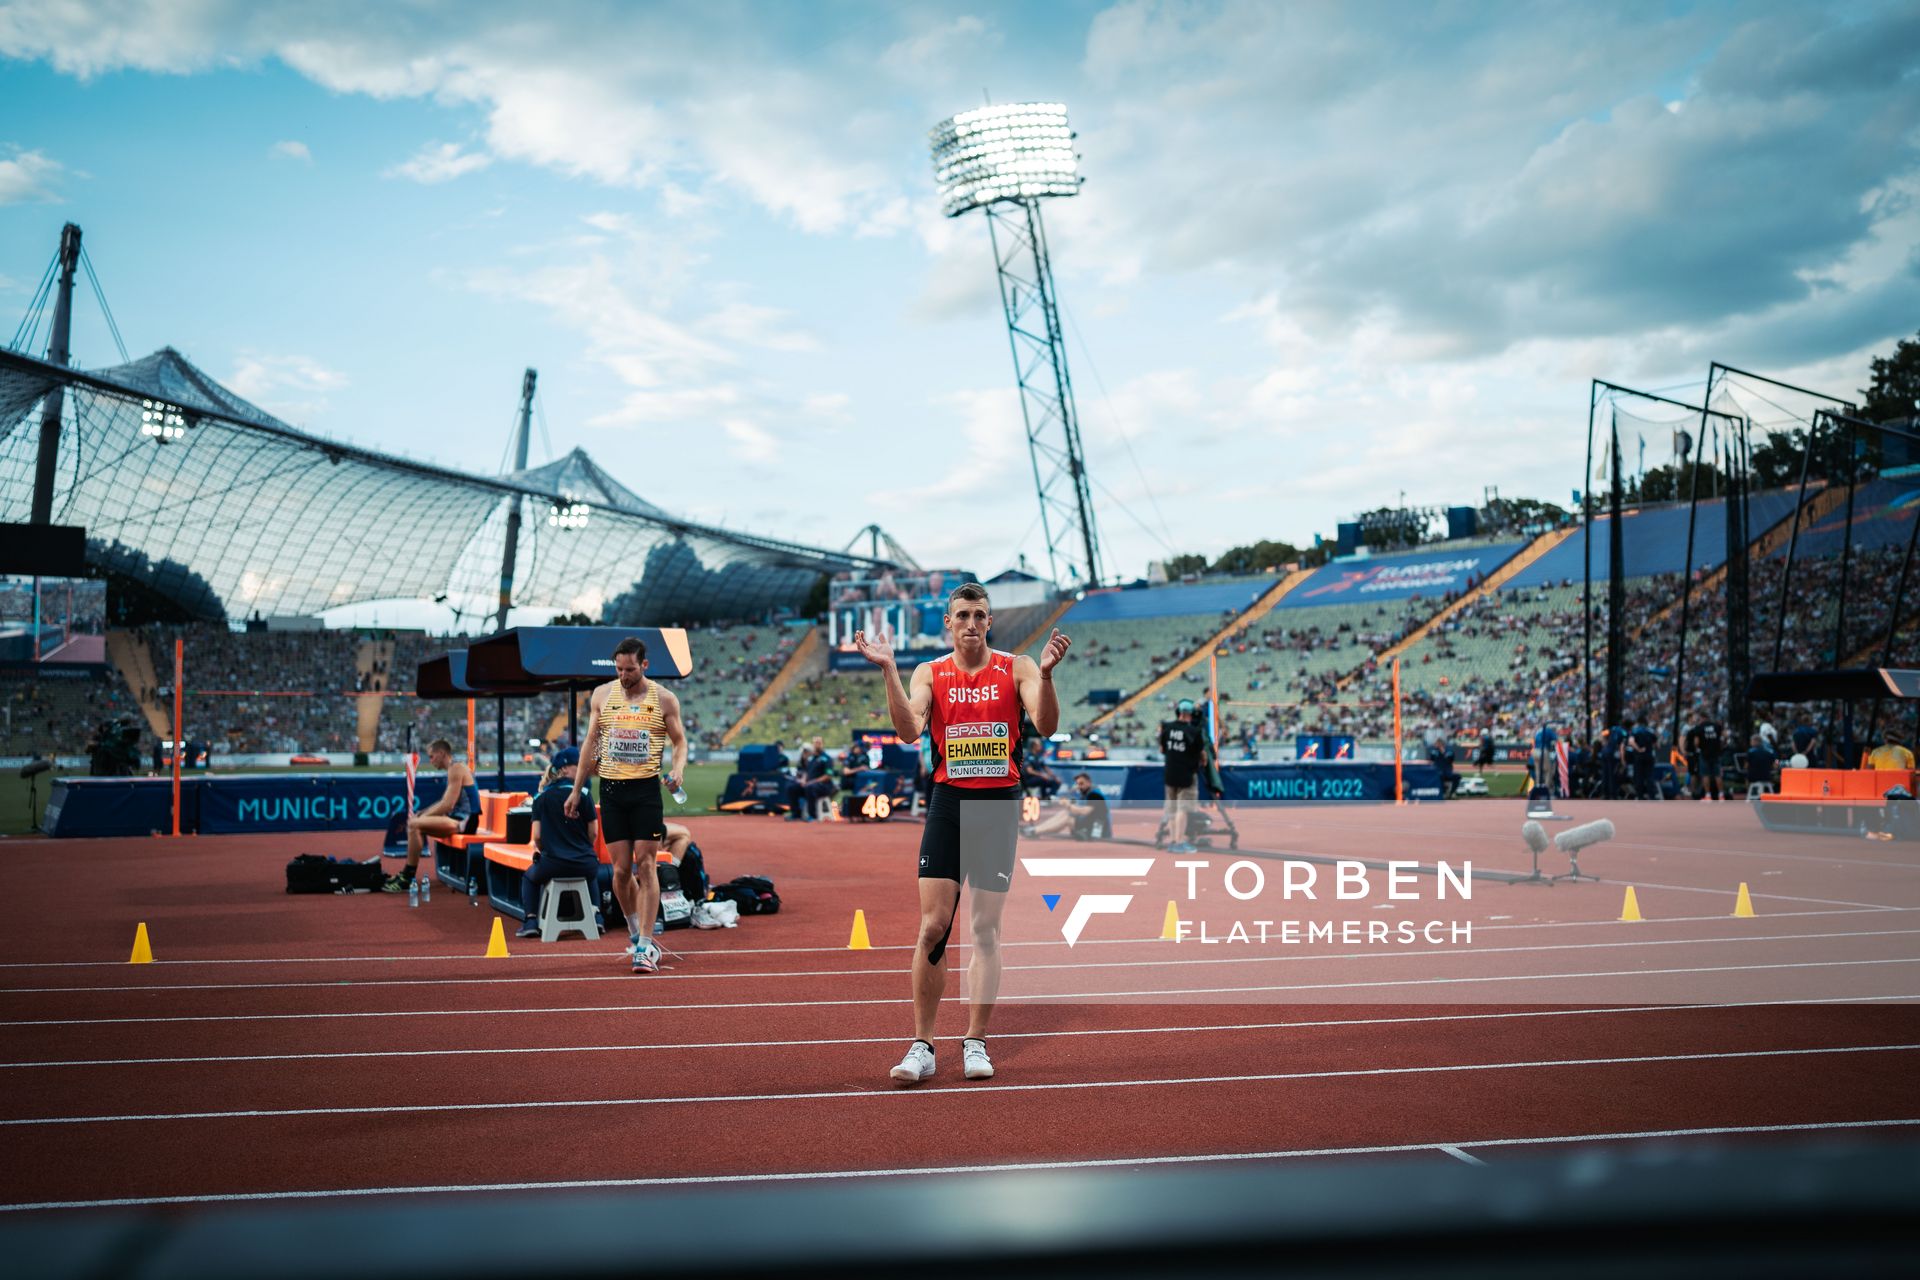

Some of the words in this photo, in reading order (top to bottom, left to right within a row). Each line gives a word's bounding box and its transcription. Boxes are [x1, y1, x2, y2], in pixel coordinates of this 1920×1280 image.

[948, 725, 992, 737] SPAR
[948, 743, 1007, 758] EHAMMER
[950, 766, 984, 776] MUNICH
[986, 766, 1006, 775] 2022
[1248, 779, 1317, 798] MUNICH
[1322, 778, 1363, 797] 2022
[238, 796, 348, 822] MUNICH
[861, 794, 891, 819] 46
